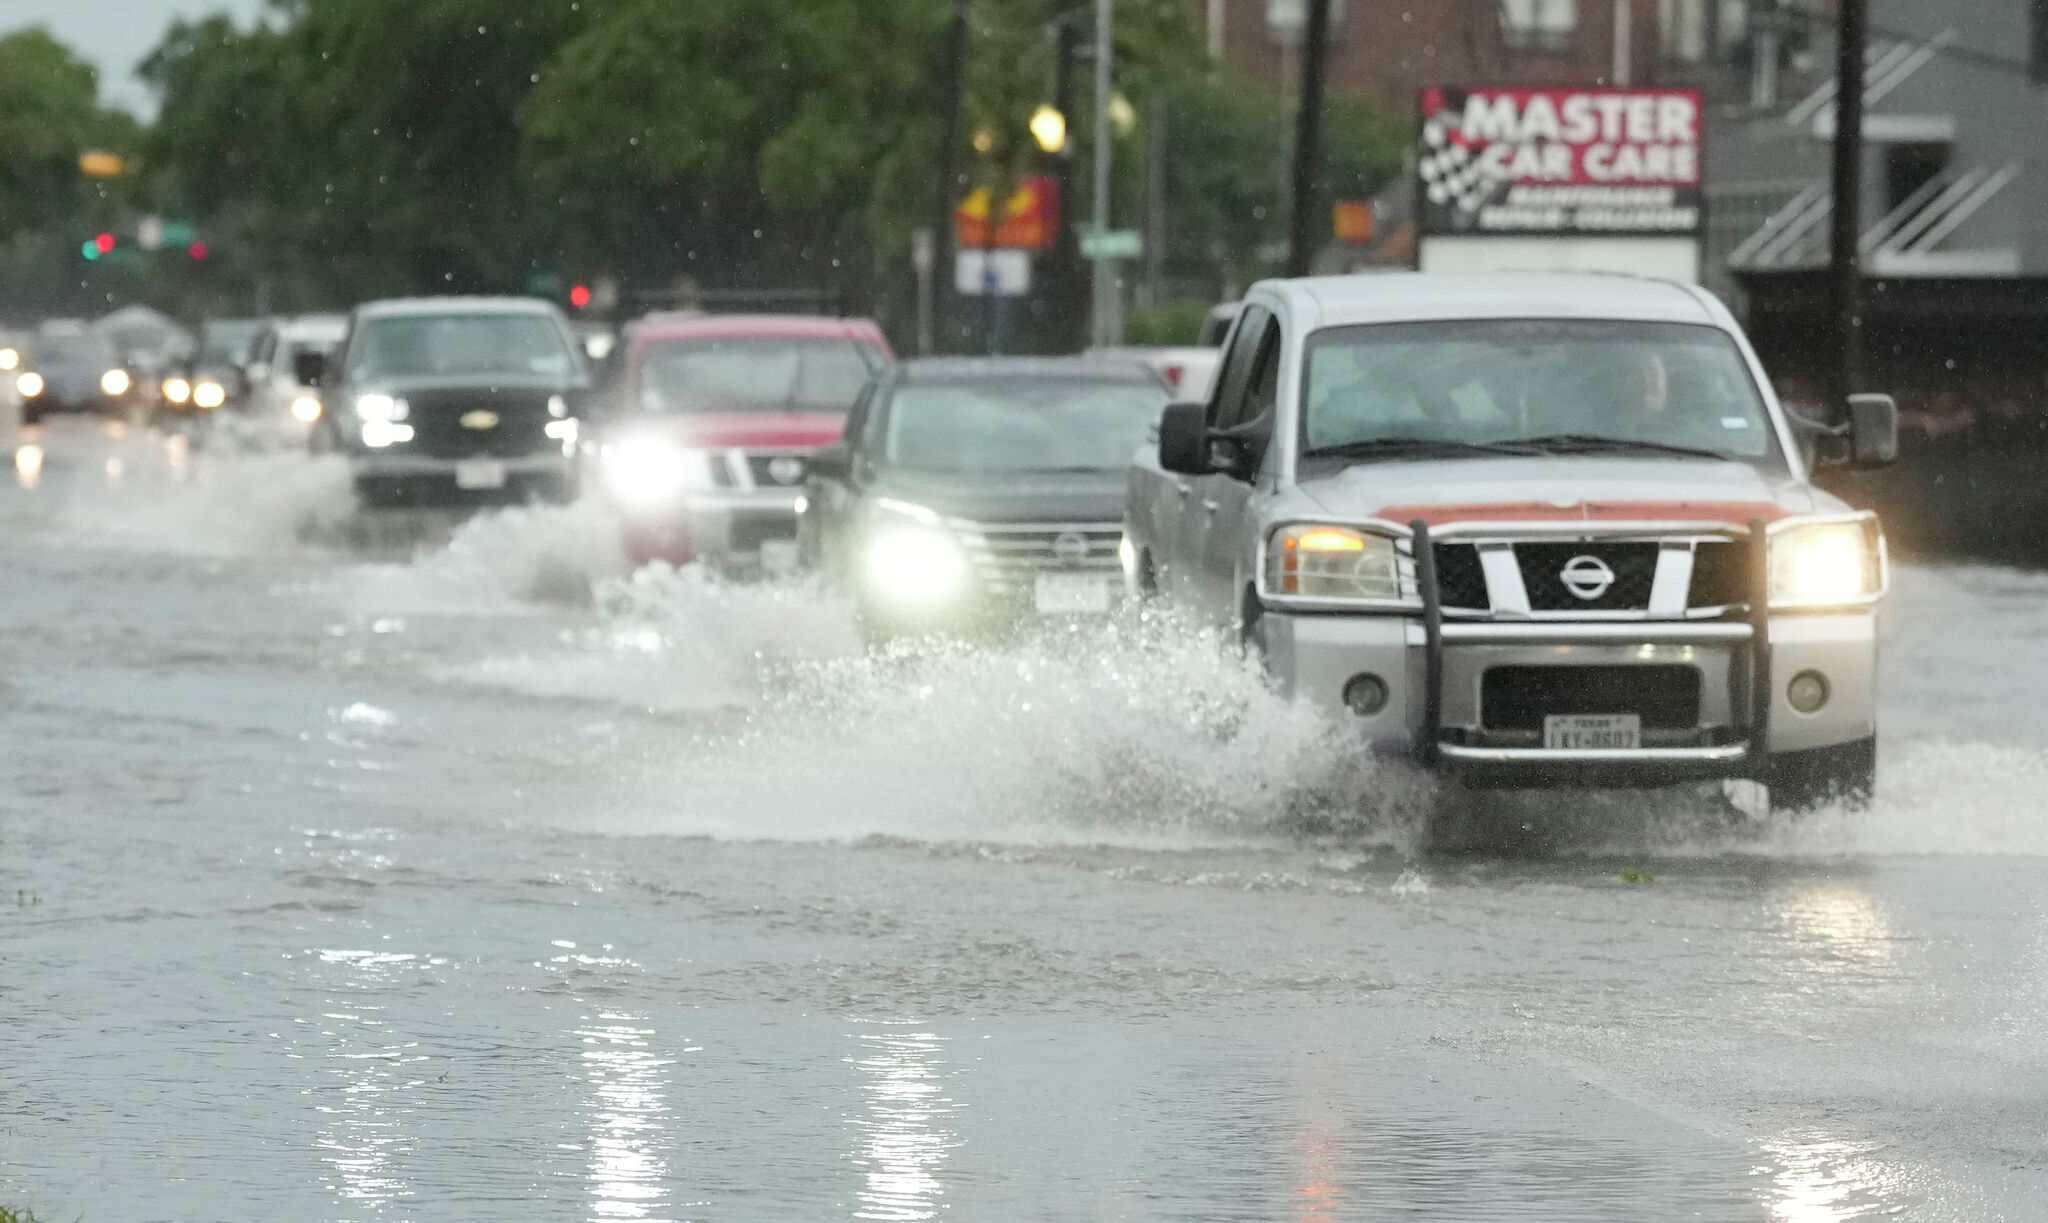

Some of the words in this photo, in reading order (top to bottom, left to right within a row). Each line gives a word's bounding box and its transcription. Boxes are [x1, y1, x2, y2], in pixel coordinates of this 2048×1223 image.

[1462, 93, 1696, 142] MASTER
[1481, 144, 1573, 181] CAR
[1584, 144, 1697, 181] CARE
